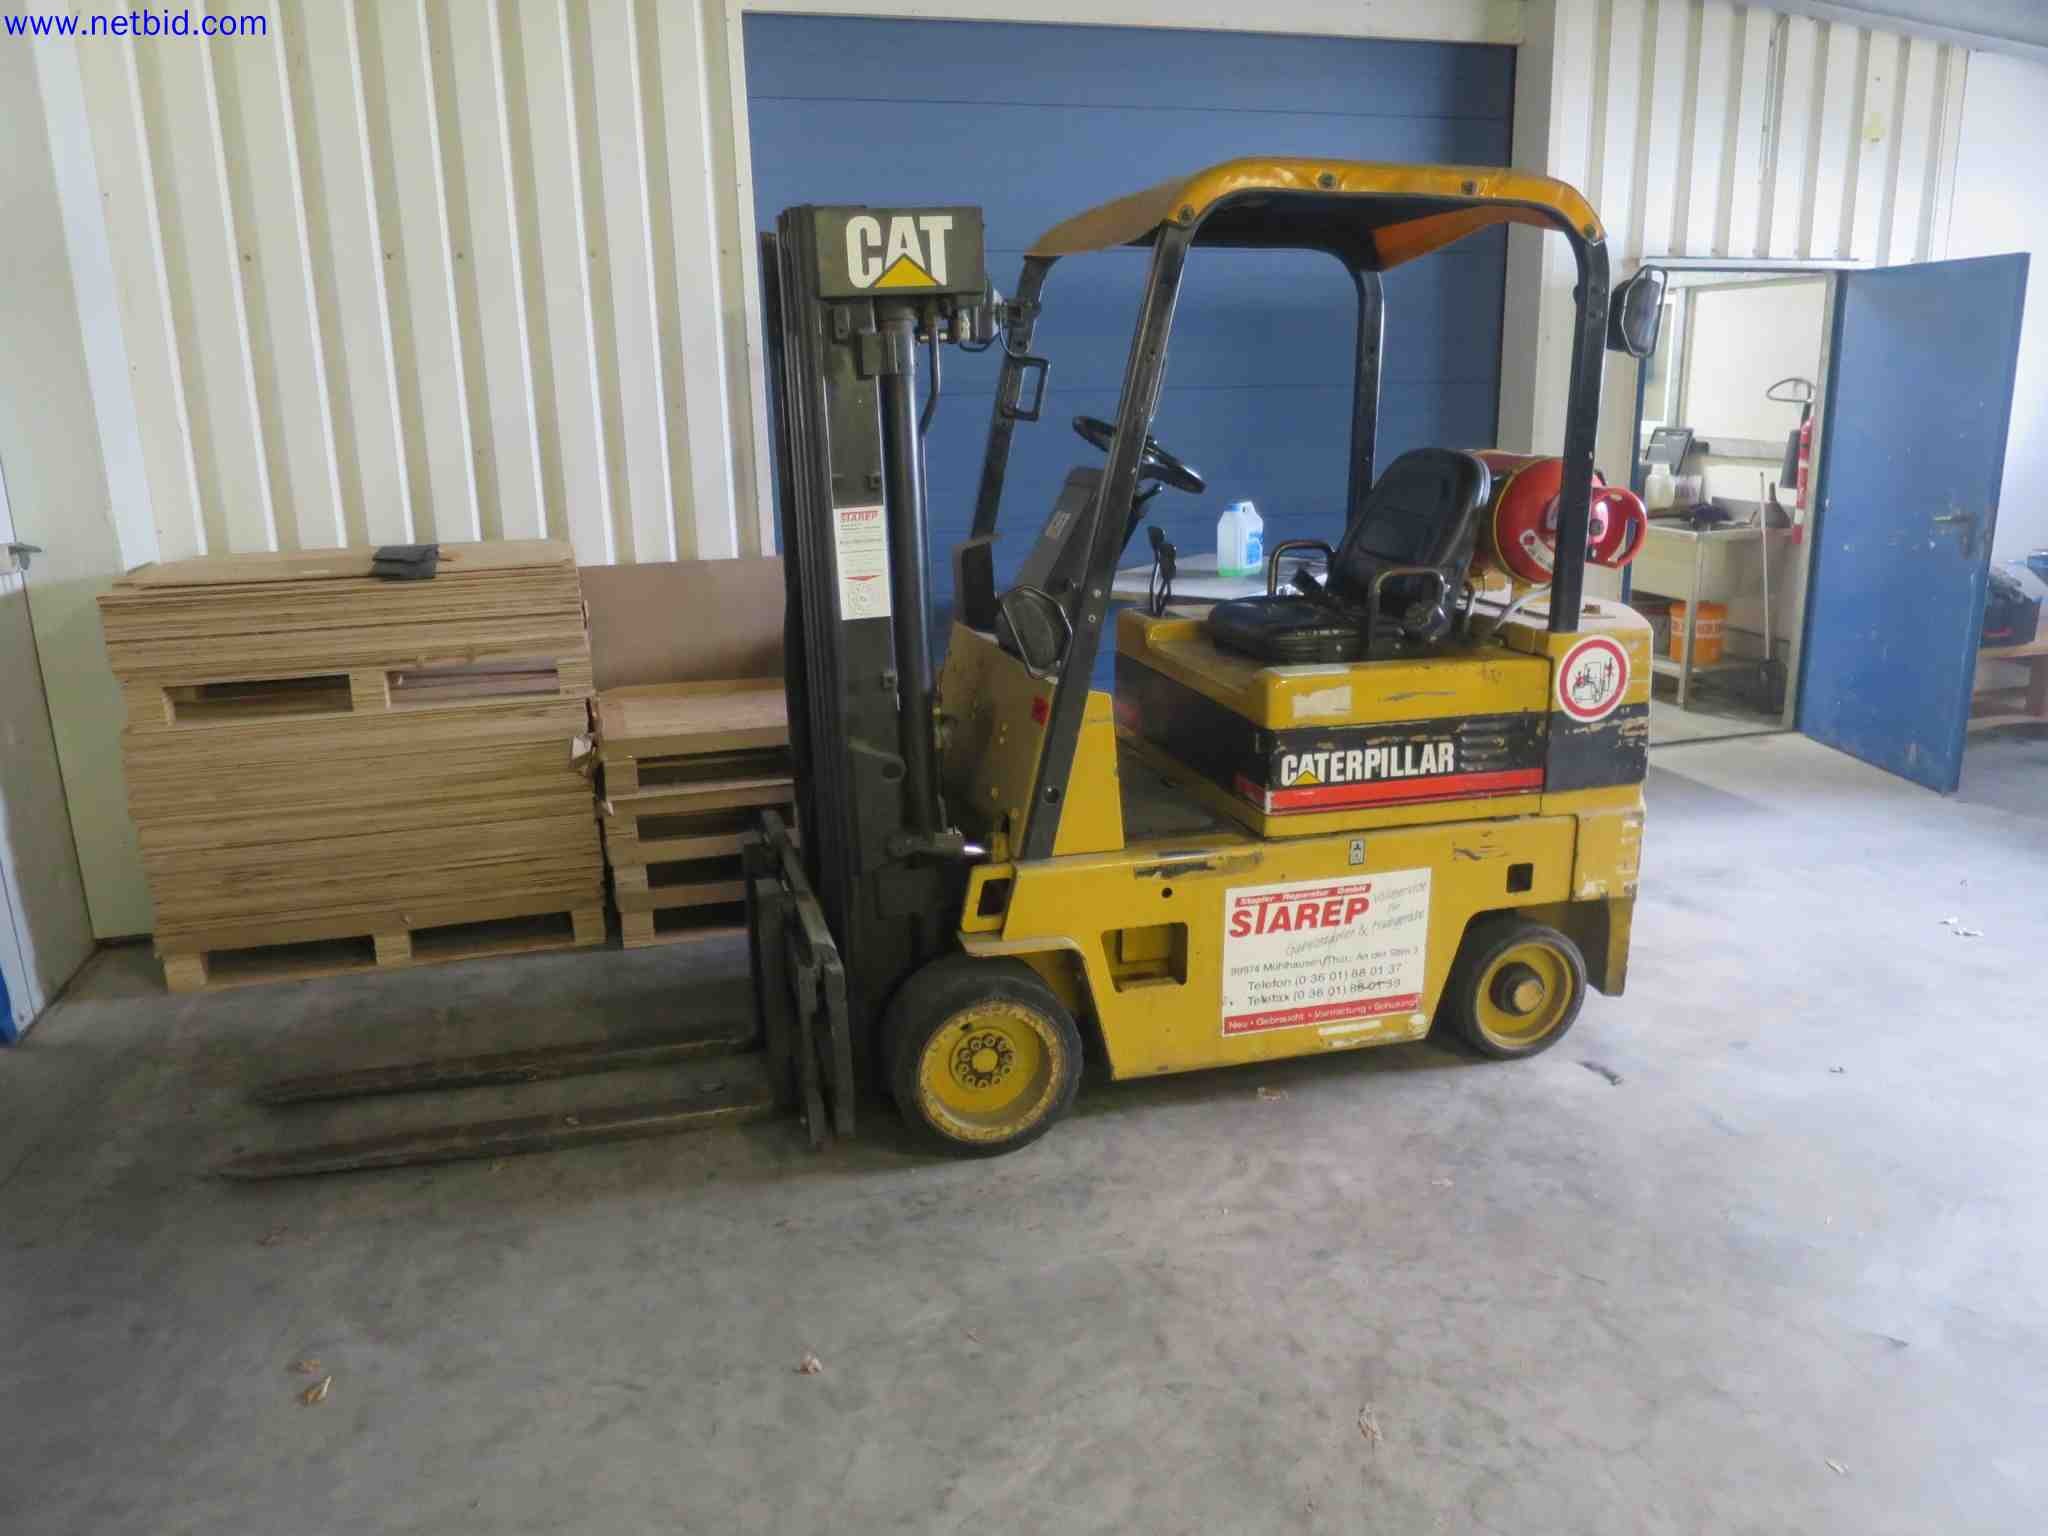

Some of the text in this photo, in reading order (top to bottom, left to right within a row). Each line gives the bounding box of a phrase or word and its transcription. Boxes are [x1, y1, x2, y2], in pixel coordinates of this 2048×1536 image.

[846, 215, 953, 289] CAT
[1280, 742, 1455, 787] CATERPILLAR
[1230, 897, 1370, 938] STAREP
[1248, 976, 1292, 991] Telefon
